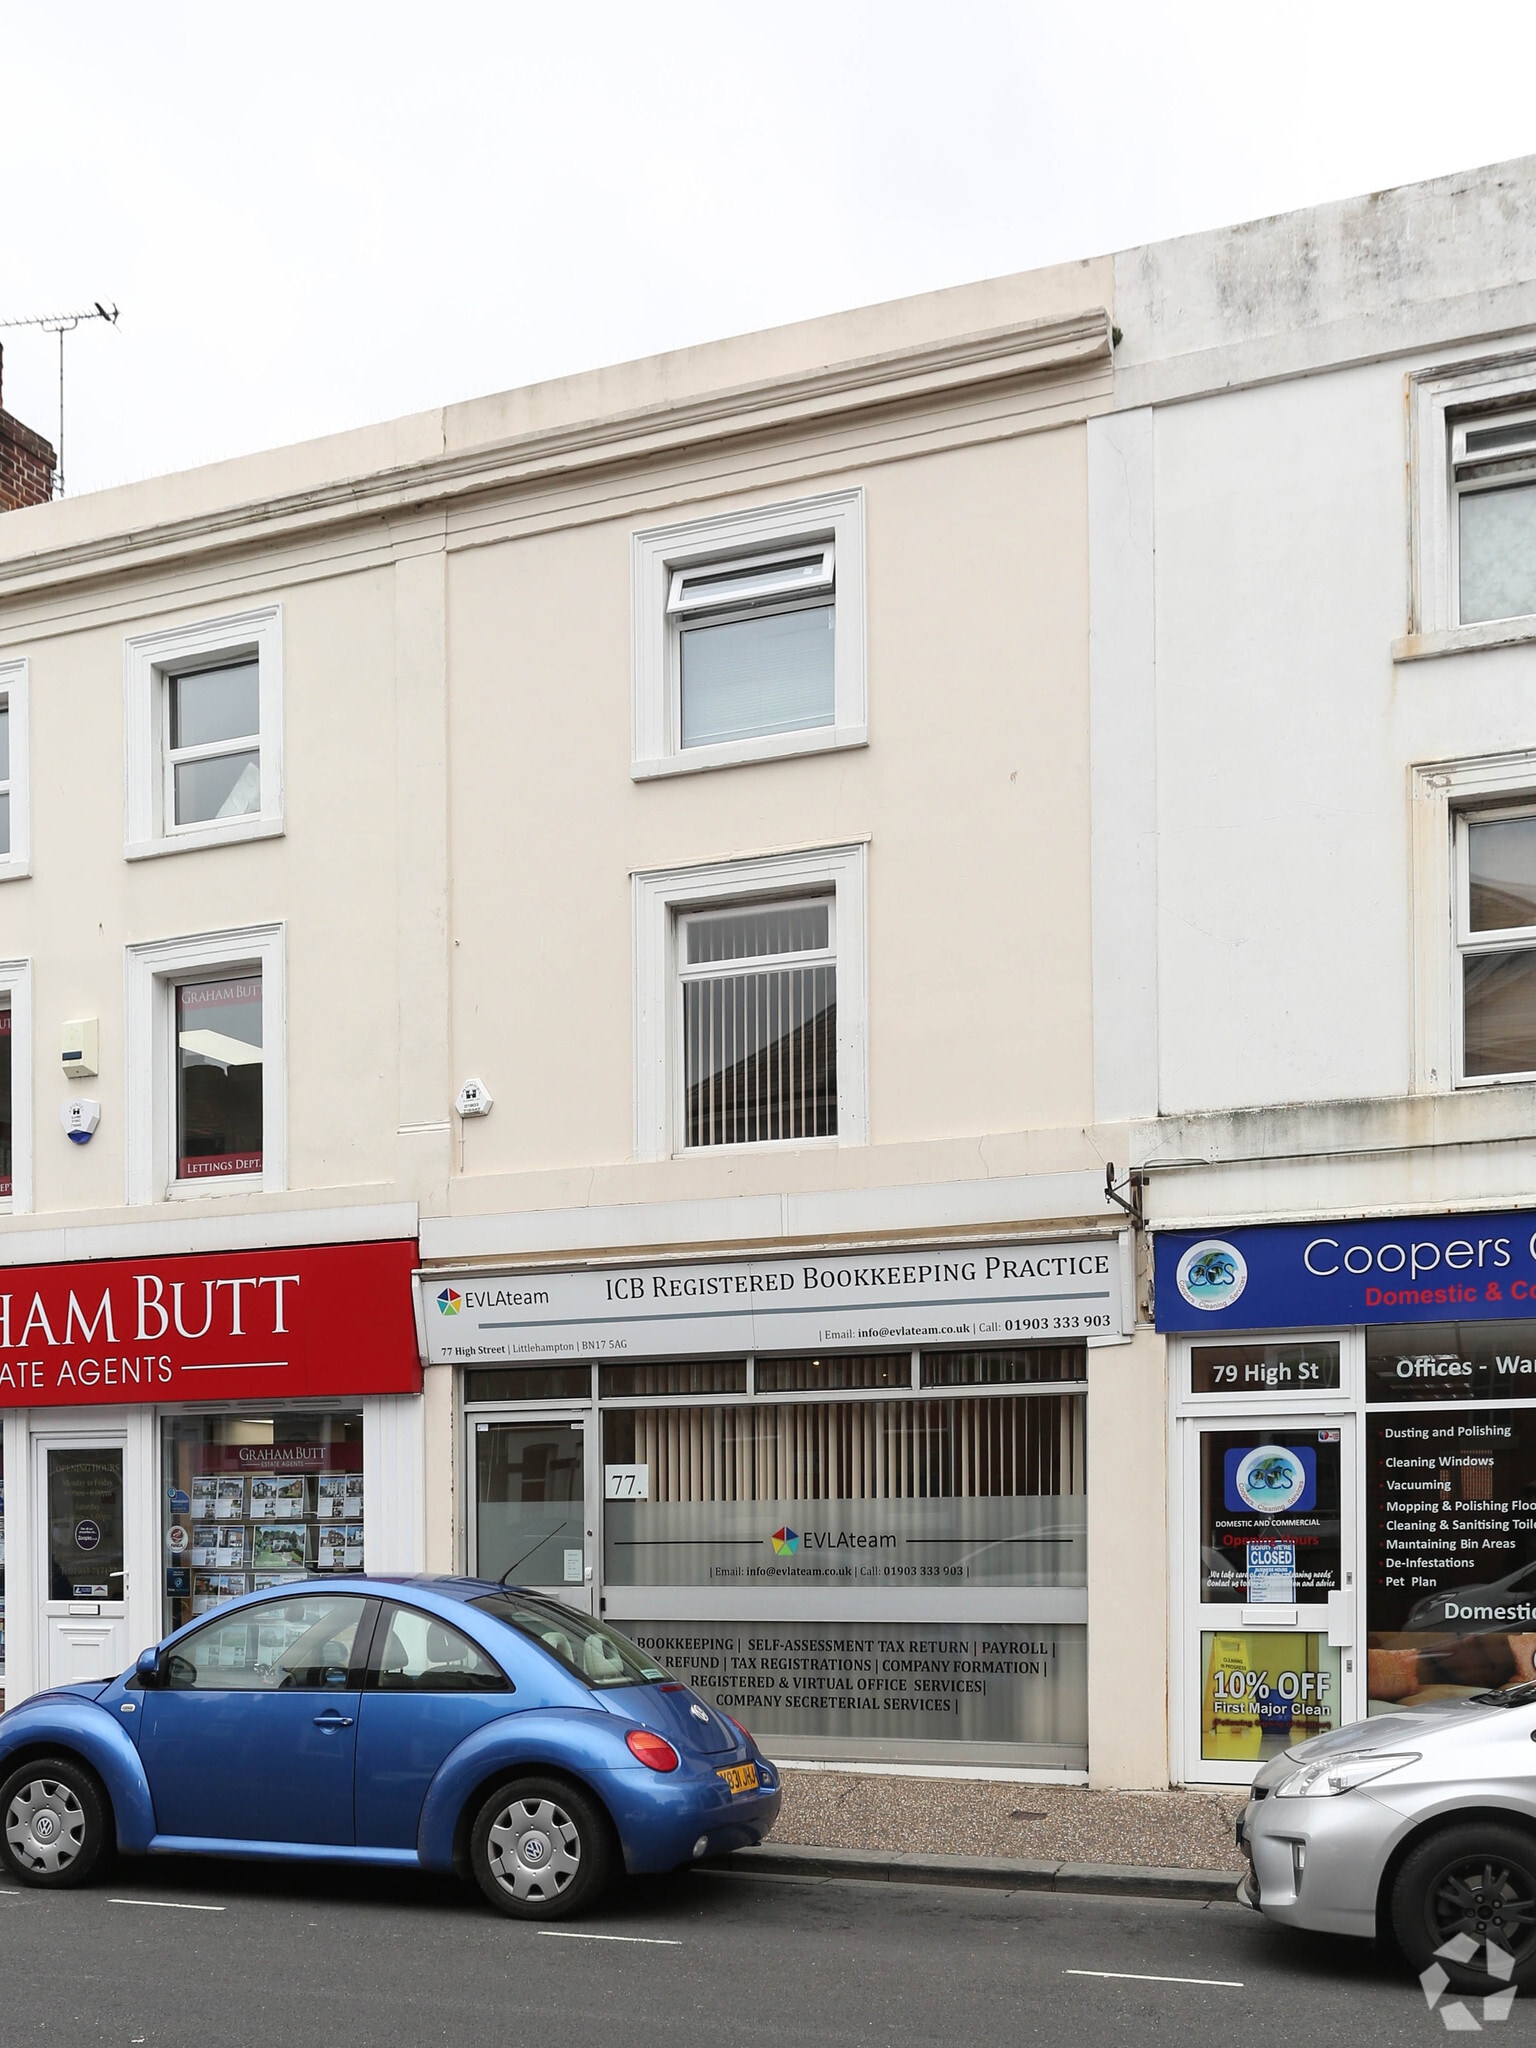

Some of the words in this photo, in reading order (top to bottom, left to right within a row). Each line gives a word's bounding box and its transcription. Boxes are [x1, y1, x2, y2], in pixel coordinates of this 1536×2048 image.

[182, 988, 234, 1004] GRAHAM
[187, 1159, 233, 1174] LETTINGS
[1303, 1237, 1511, 1280] Coopers
[605, 1277, 645, 1301] ICB
[652, 1273, 795, 1298] REGISTERED
[803, 1261, 977, 1290] BOOKKEEPING
[985, 1255, 1110, 1280] PRACTICE
[1188, 1262, 1235, 1287] CCS
[465, 1288, 550, 1308] EVLAteam
[1365, 1284, 1478, 1307] Domestic
[1485, 1281, 1503, 1301] &
[132, 1274, 300, 1341] BUTT
[824, 1328, 856, 1340] Email:
[858, 1323, 970, 1338] info@evlateam.co.uk
[979, 1321, 1002, 1333] Call:
[1004, 1317, 1049, 1332] 01903
[1053, 1316, 1080, 1330] 333
[1083, 1314, 1111, 1328] 903
[441, 1347, 453, 1356] 77
[455, 1346, 476, 1357] High
[477, 1345, 506, 1354] Street
[512, 1341, 575, 1355] Littlehampton
[582, 1340, 607, 1350] BN17
[609, 1339, 627, 1349] 5AG
[56, 1355, 172, 1386] AGENTS
[1213, 1365, 1238, 1383] 79
[1244, 1362, 1292, 1385] High
[1298, 1362, 1319, 1380] St
[1396, 1357, 1473, 1378] Offices
[1385, 1427, 1429, 1440] Dusting
[1432, 1426, 1454, 1437] and
[1458, 1425, 1511, 1437] Polishing
[239, 1448, 293, 1461] GRAHAM
[296, 1447, 326, 1459] BUTT
[1385, 1457, 1436, 1469] Cleaning
[1438, 1456, 1495, 1467] Windows
[1248, 1468, 1293, 1490] CCS
[1387, 1480, 1451, 1492] Vacuuming
[1387, 1501, 1439, 1513] Mopping
[1442, 1501, 1452, 1511] &
[1455, 1500, 1509, 1513] Polishing
[1216, 1520, 1252, 1528] DOMESTIC
[1271, 1519, 1320, 1527] COMMERCIAL
[1386, 1520, 1436, 1532] Cleaning
[1439, 1520, 1449, 1530] &
[1452, 1519, 1510, 1531] Sanitising
[1512, 1519, 1536, 1530] Toil
[803, 1531, 897, 1549] EVLAteam
[1386, 1538, 1457, 1551] Maintaining
[1461, 1538, 1479, 1549] Bin
[1482, 1539, 1516, 1549] Areas
[1251, 1551, 1292, 1565] CLOSED
[1386, 1557, 1475, 1568] De-Infestations
[715, 1567, 744, 1577] Email:
[746, 1566, 852, 1577] info@evlateam.co.uk
[860, 1566, 881, 1577] Call:
[883, 1566, 918, 1577] 01903
[919, 1566, 941, 1576] 333
[943, 1566, 963, 1576] 903
[1206, 1579, 1230, 1587] Contact
[1302, 1579, 1314, 1587] and
[1315, 1579, 1335, 1587] advice
[1386, 1577, 1405, 1587] Pet
[1411, 1577, 1437, 1587] Plan
[637, 1637, 734, 1651] BOOKKEEPING
[748, 1638, 874, 1652] SELF-ASSESSMENT
[878, 1640, 905, 1653] TAX
[909, 1641, 969, 1654] RETURN
[982, 1642, 1048, 1655] PAYROLL
[666, 1656, 720, 1669] REFUND
[731, 1657, 757, 1670] TAX
[760, 1657, 871, 1671] REGISTRATIONS
[882, 1659, 950, 1673] COMPANY
[953, 1661, 1040, 1674] FORMATION
[691, 1675, 775, 1689] REGISTERED
[779, 1677, 789, 1689] &
[793, 1677, 853, 1690] VIRTUAL
[857, 1679, 907, 1692] OFFICE
[1214, 1671, 1270, 1699] 10%
[1277, 1671, 1331, 1700] OFF
[716, 1694, 782, 1707] COMPANY
[785, 1696, 880, 1709] SECRETERIAL
[883, 1698, 951, 1712] SERVICES
[1214, 1702, 1245, 1714] First
[1249, 1702, 1288, 1717] Major
[1291, 1703, 1331, 1715] Clean
